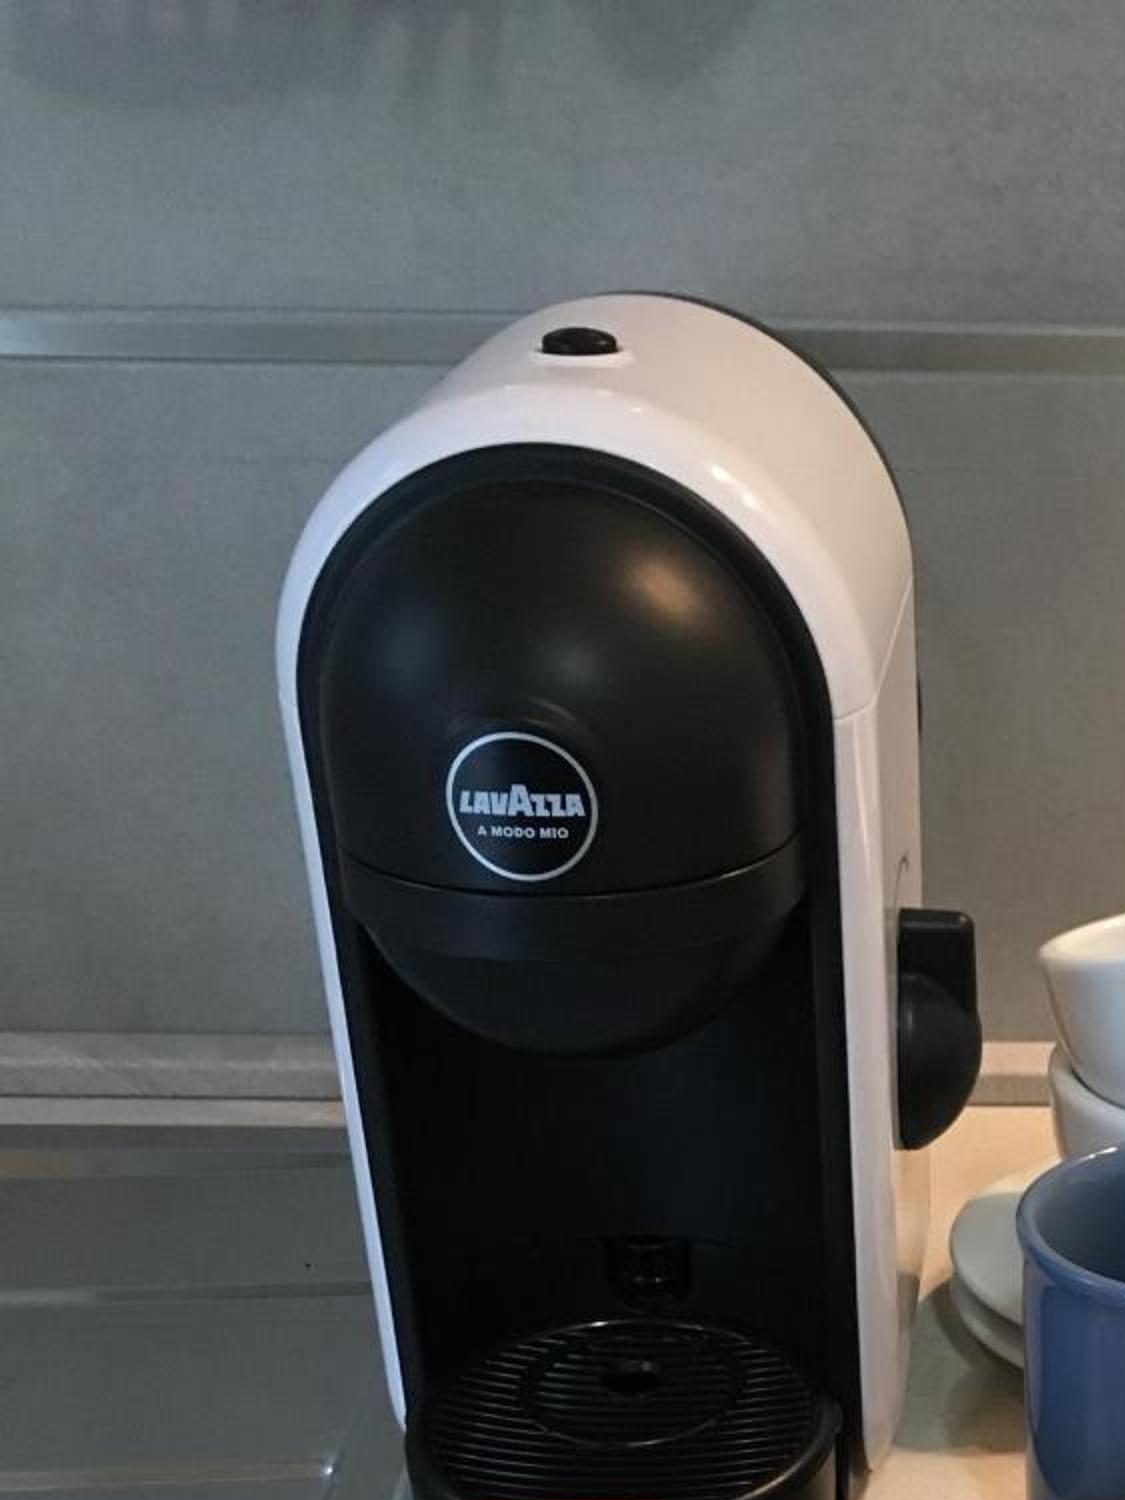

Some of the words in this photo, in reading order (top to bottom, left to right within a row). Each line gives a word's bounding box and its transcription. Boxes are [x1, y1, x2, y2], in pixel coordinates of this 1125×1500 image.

[459, 784, 586, 817] LAVAZZA
[477, 825, 487, 836] A
[491, 826, 535, 839] MODO
[539, 827, 569, 839] MIO
